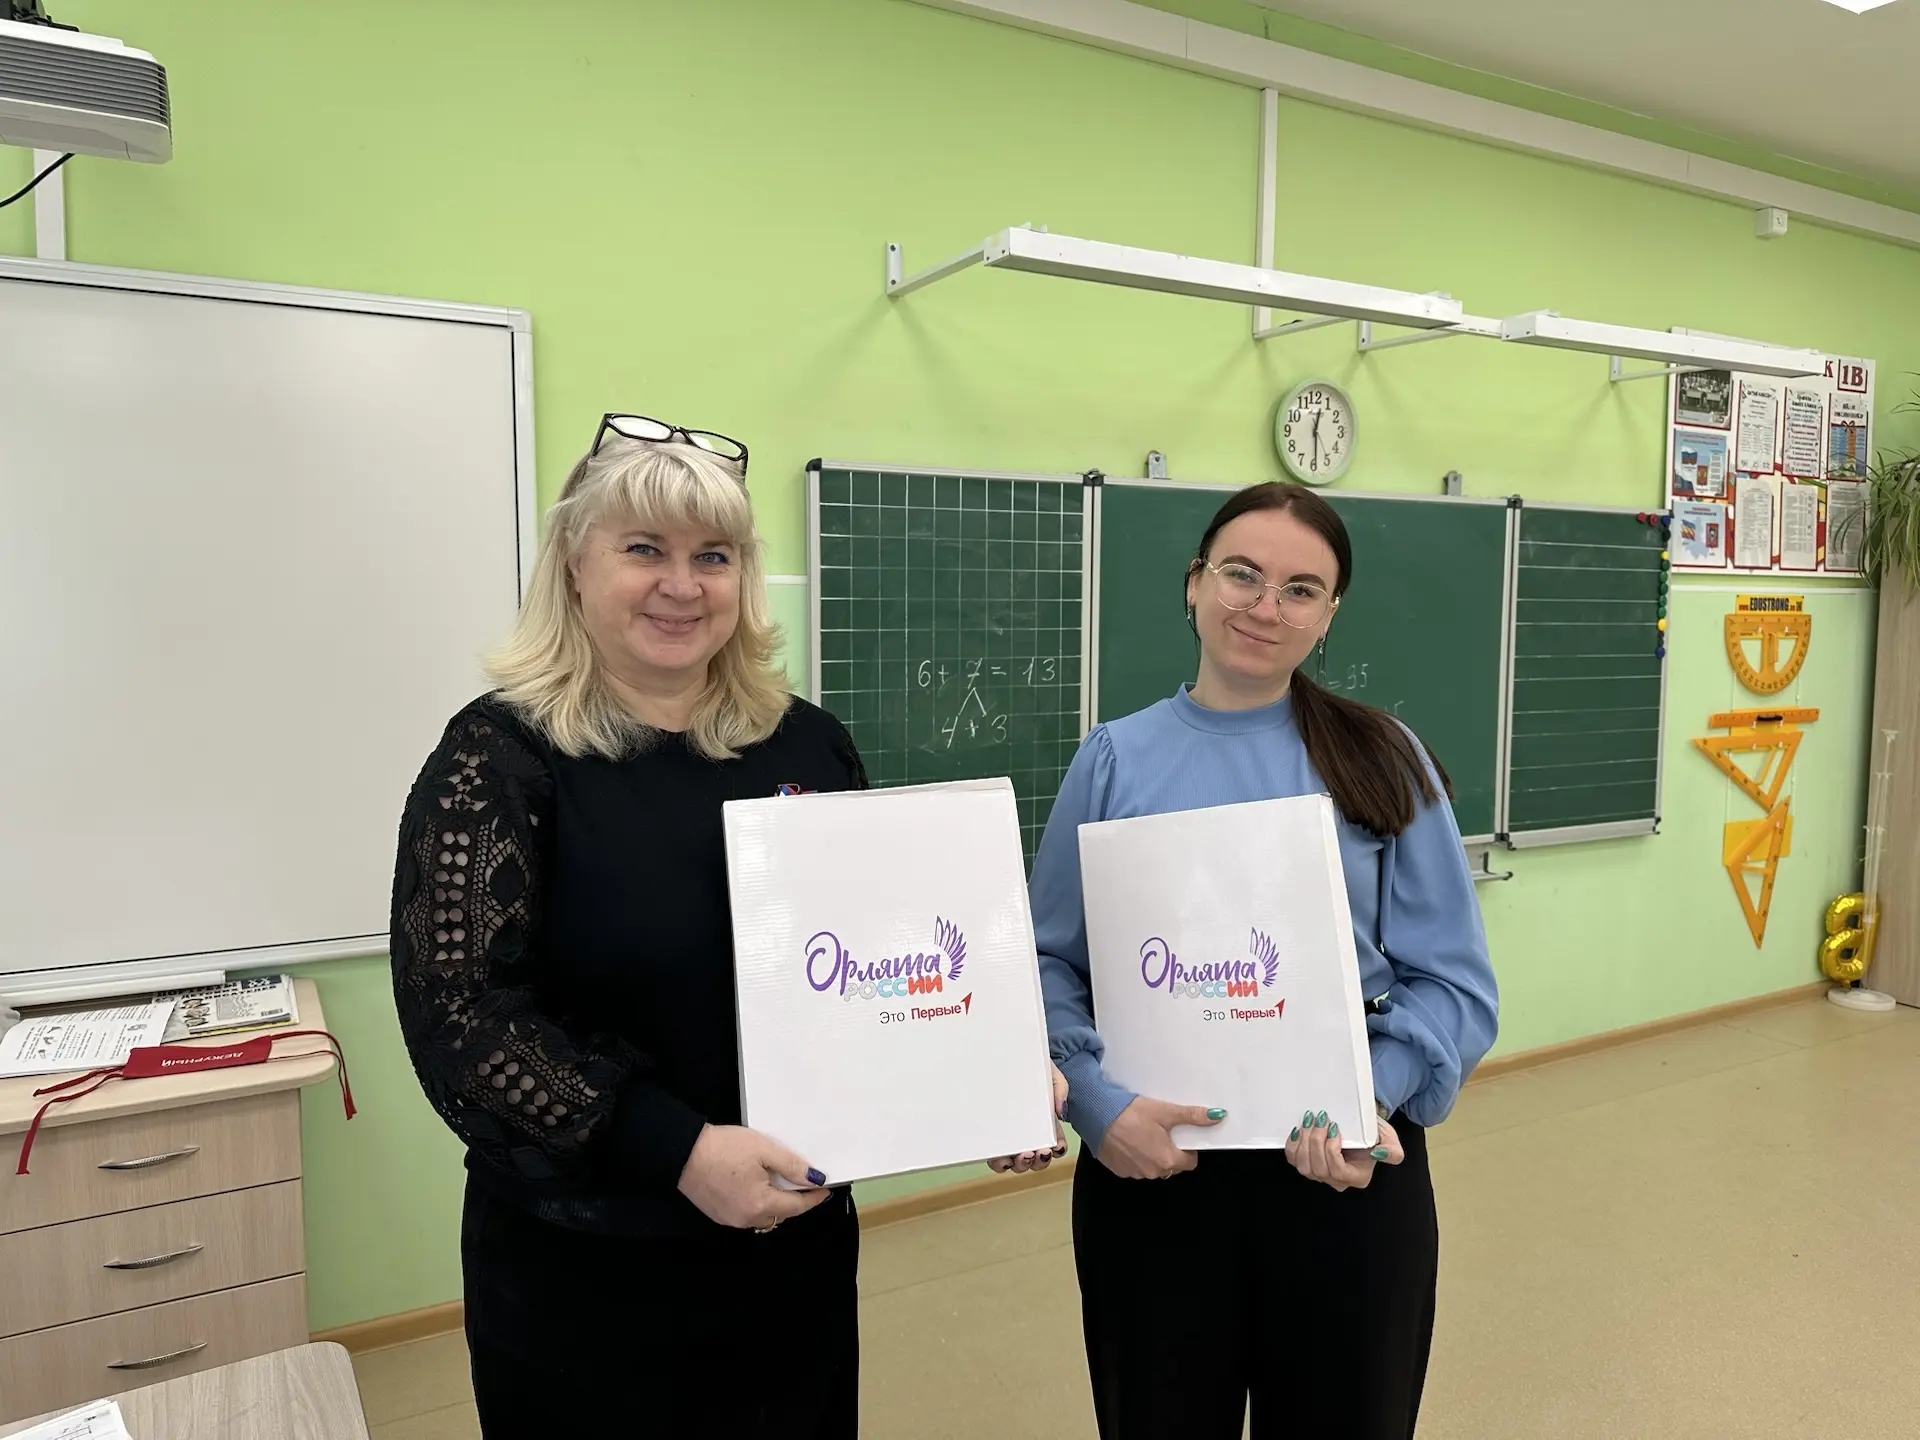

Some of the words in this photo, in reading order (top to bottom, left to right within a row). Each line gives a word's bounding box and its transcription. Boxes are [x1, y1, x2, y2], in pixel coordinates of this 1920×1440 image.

[1297, 396, 1309, 409] 11
[1309, 391, 1322, 404] 12
[1325, 397, 1331, 410] 1
[1288, 409, 1301, 422] 10
[1332, 410, 1340, 423] 2
[1284, 424, 1291, 437] 9
[1337, 425, 1345, 438] 3
[1288, 439, 1296, 453] 8
[1332, 440, 1340, 453] 4
[1297, 453, 1305, 467] 7
[1310, 459, 1317, 471] 6
[1323, 453, 1331, 467] 5
[805, 931, 941, 995] Орлята
[1140, 937, 1257, 993] Орлята
[844, 974, 943, 1002] РОССИИ
[1173, 980, 1259, 999] РОССИИ
[879, 1011, 905, 1024] Это
[911, 1004, 962, 1021] Первые
[1203, 1010, 1226, 1021] Это
[1230, 1008, 1276, 1022] Первые
[161, 1051, 244, 1067] ДЕЖУРНЫЙ
